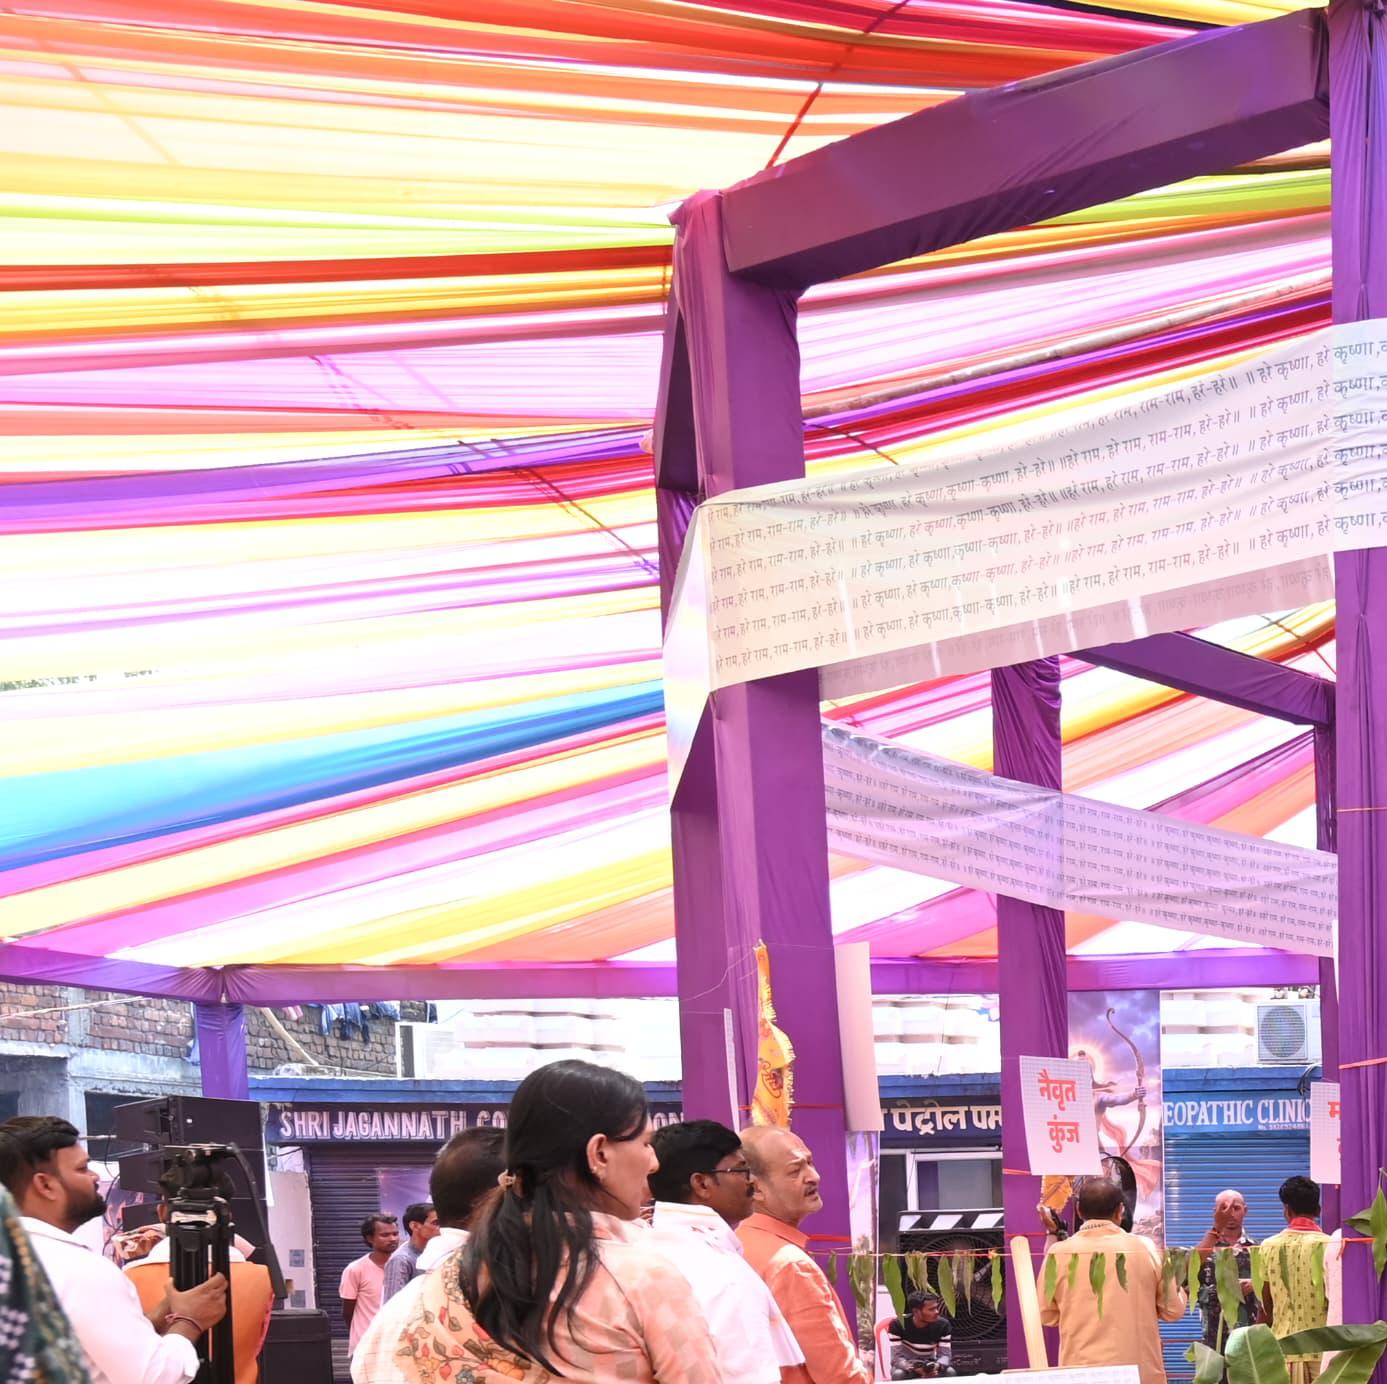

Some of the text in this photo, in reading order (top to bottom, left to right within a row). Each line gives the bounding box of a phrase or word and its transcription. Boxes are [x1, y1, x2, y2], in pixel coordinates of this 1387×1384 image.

[281, 1111, 329, 1139] SHRI
[333, 1109, 467, 1141] JAGANNATH
[1163, 1100, 1253, 1126] EOPATHIC
[1257, 1098, 1312, 1125] CLINIC
[1048, 1116, 1080, 1153] कुंज
